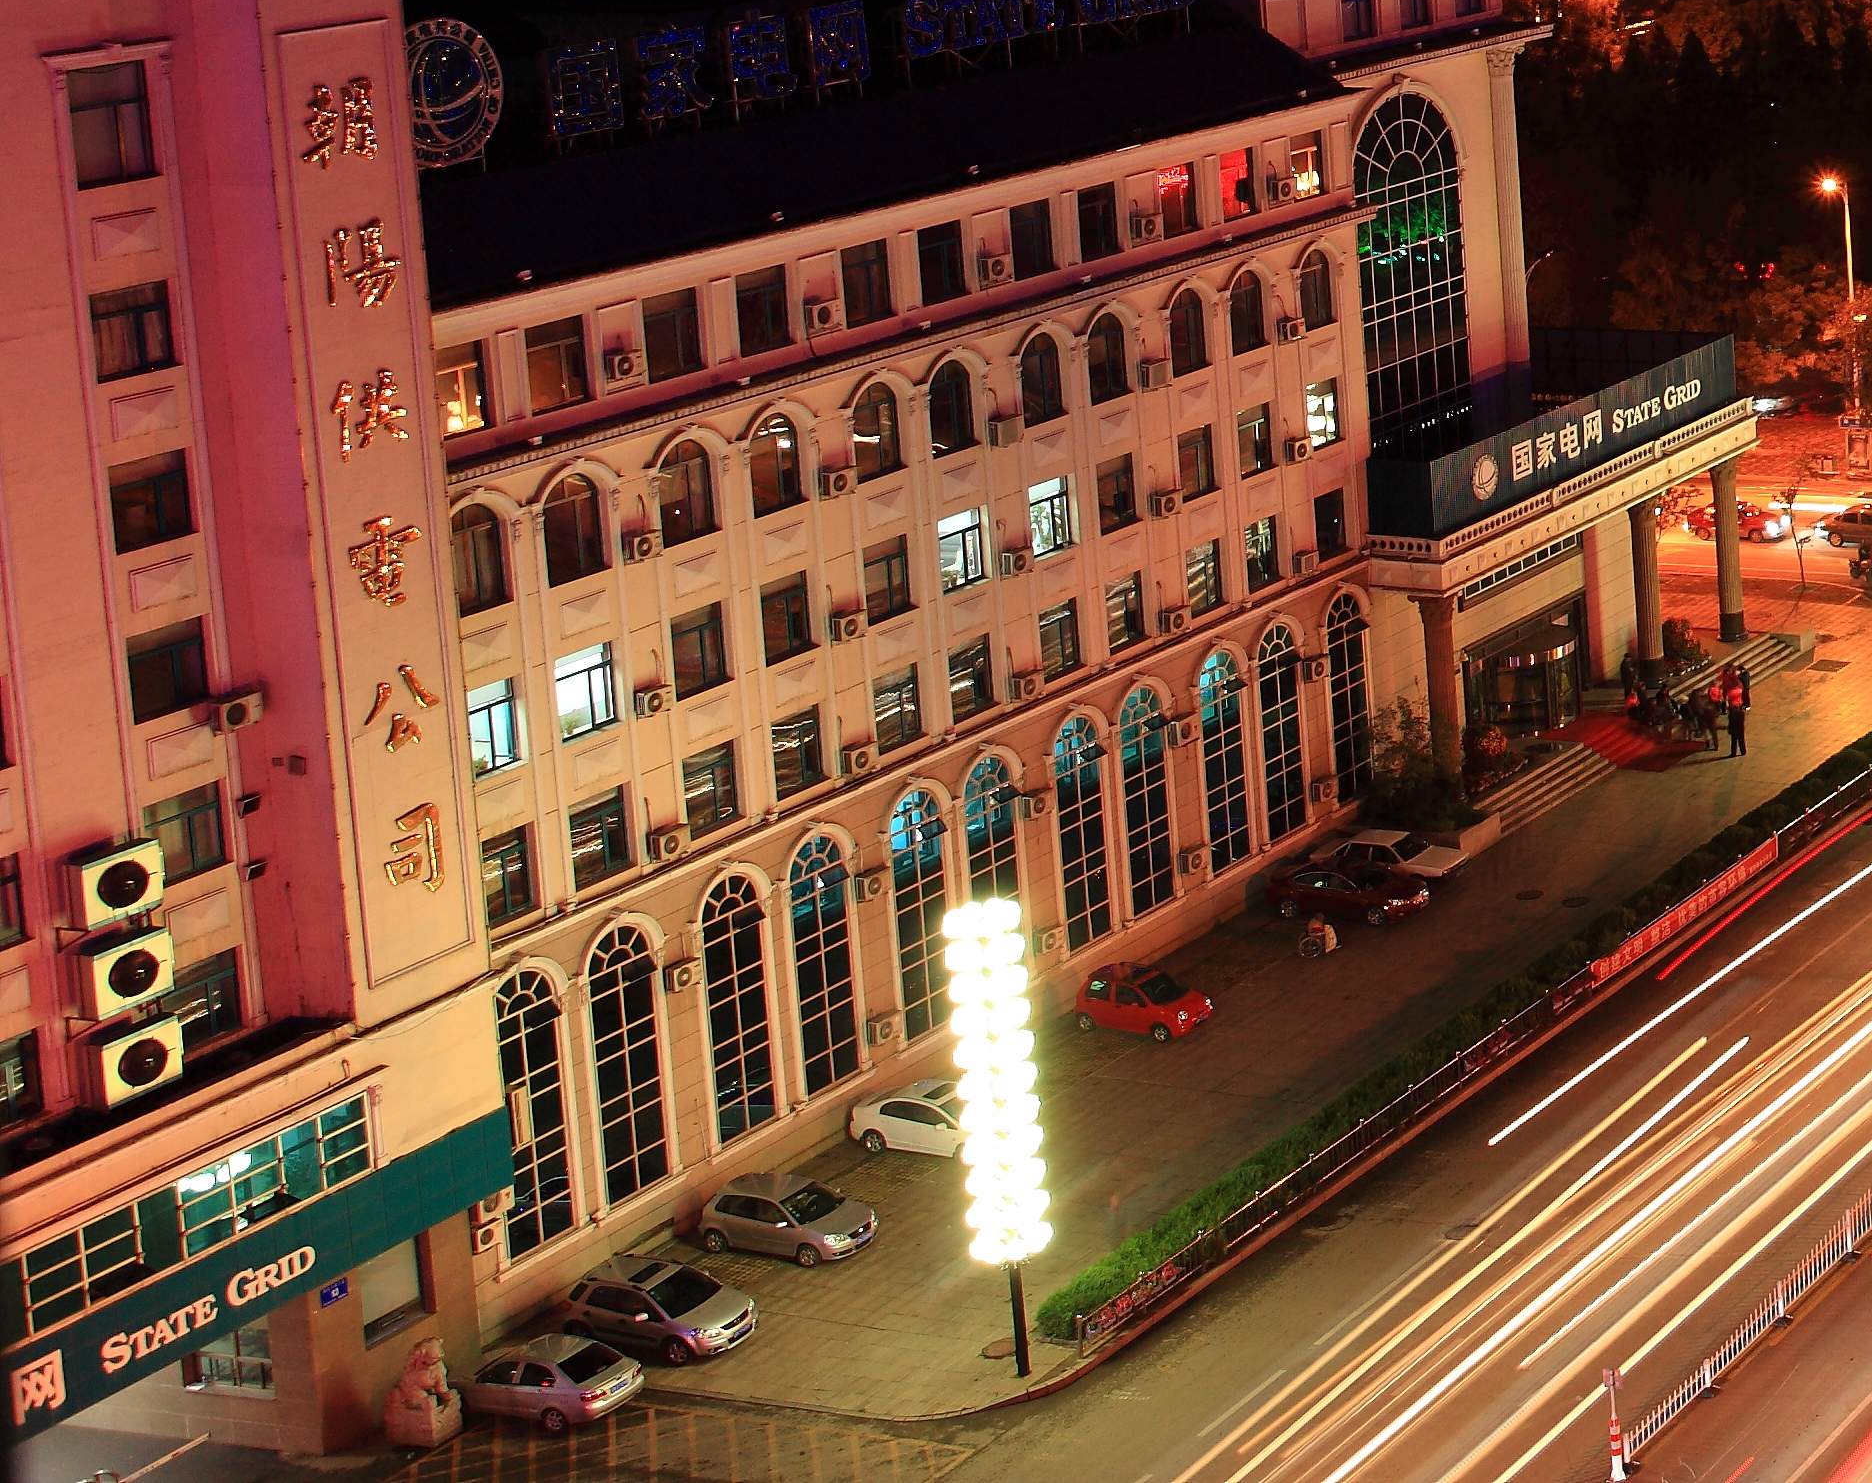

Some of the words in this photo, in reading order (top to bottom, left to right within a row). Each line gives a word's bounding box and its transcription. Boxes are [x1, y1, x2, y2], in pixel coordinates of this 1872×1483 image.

[301, 75, 446, 895] 朝陽供電公司
[1511, 409, 1603, 482] 国家电网
[1612, 396, 1662, 434] STATE
[1663, 378, 1702, 411] GRID
[10, 1348, 67, 1427] 网
[99, 1293, 219, 1375] STATE
[226, 1245, 317, 1307] GRID
